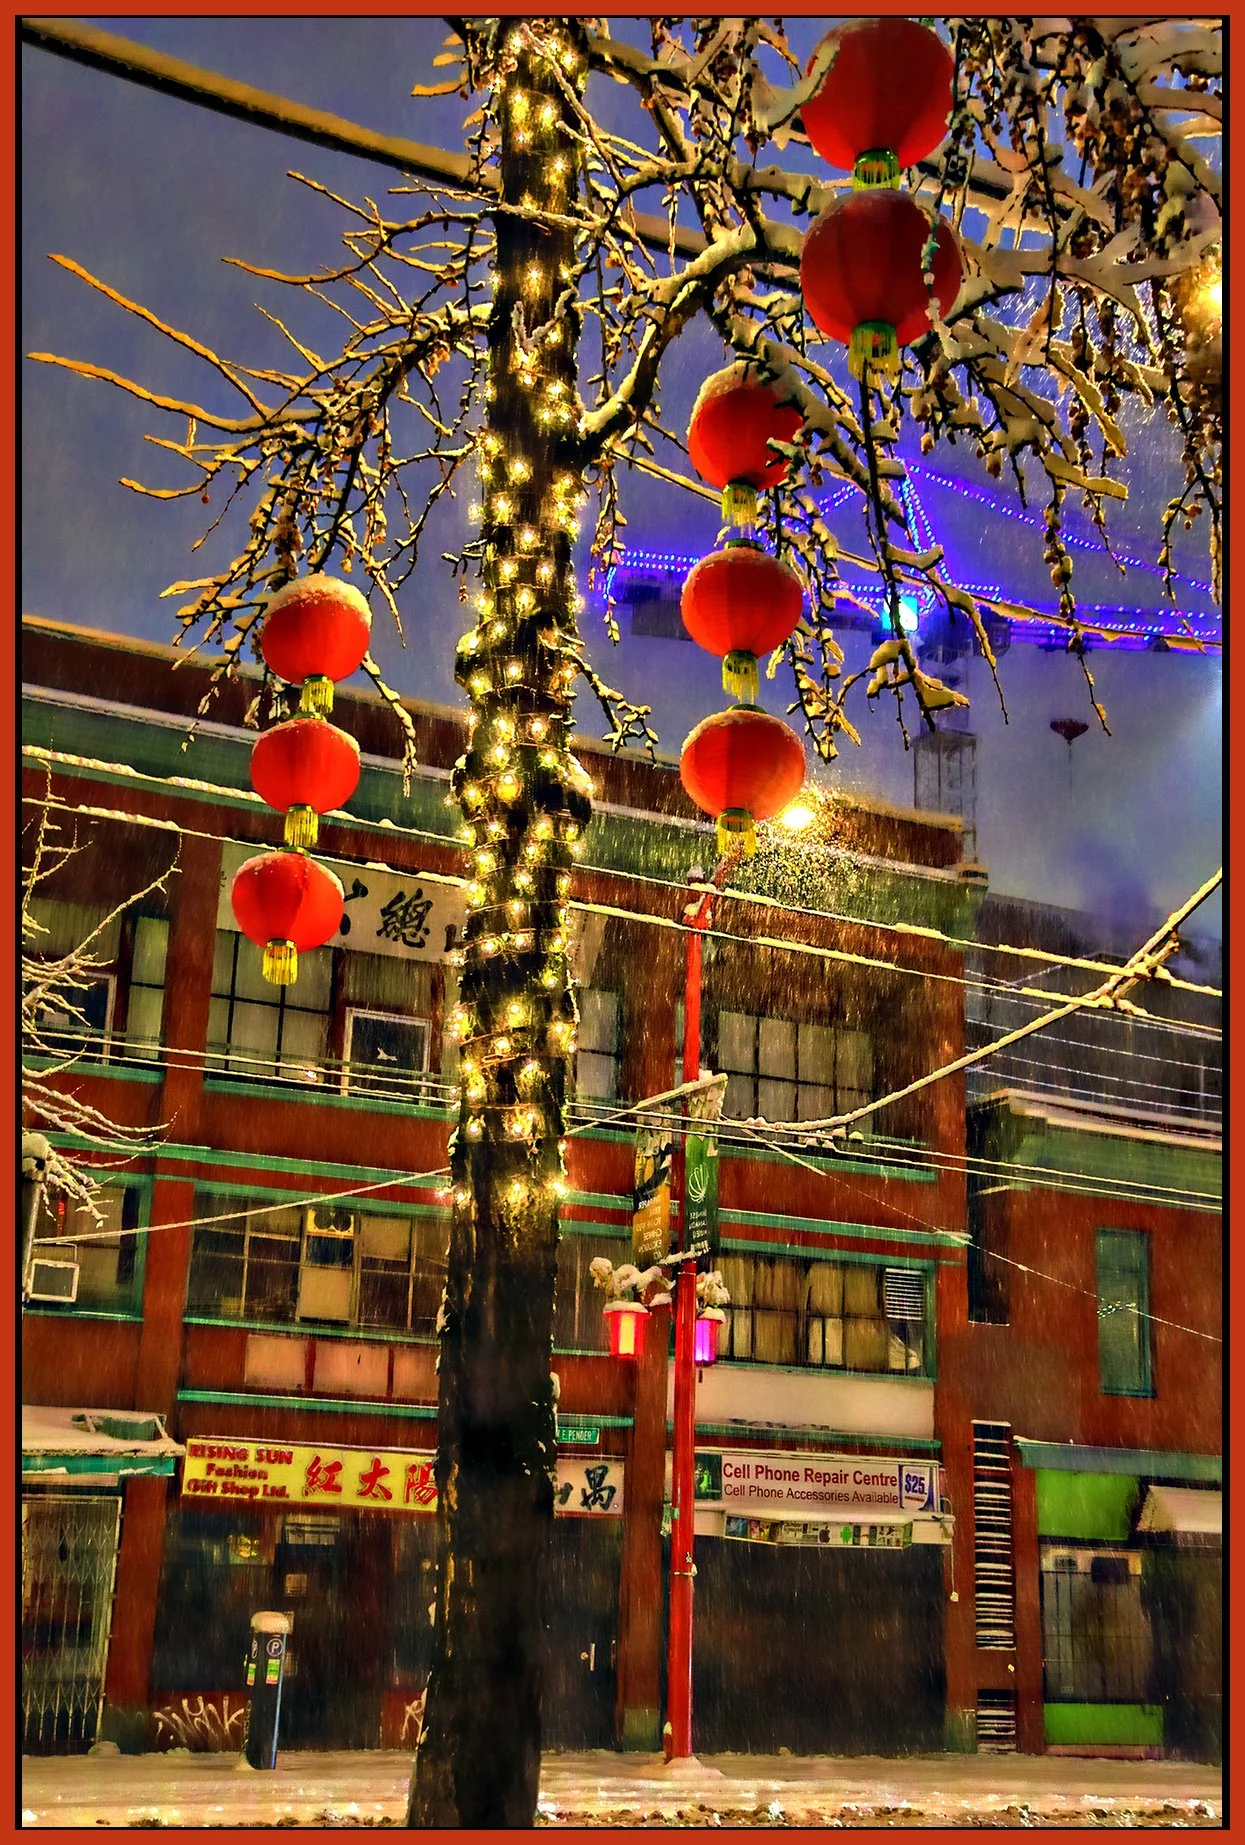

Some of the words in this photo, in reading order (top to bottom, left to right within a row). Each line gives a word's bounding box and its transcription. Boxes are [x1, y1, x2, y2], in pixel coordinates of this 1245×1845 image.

[189, 1443, 248, 1461] RISING
[256, 1447, 293, 1465] SUN
[206, 1463, 269, 1480] Fashion
[723, 1463, 750, 1479] Cell
[755, 1465, 800, 1482] Phone
[804, 1468, 849, 1487] Repair
[853, 1470, 898, 1487] Centre
[187, 1478, 218, 1493] Gift
[221, 1481, 259, 1499] Shop
[724, 1484, 746, 1496] Cell
[749, 1485, 783, 1498] Phone
[786, 1488, 850, 1502] Accessories
[852, 1490, 899, 1504] Available
